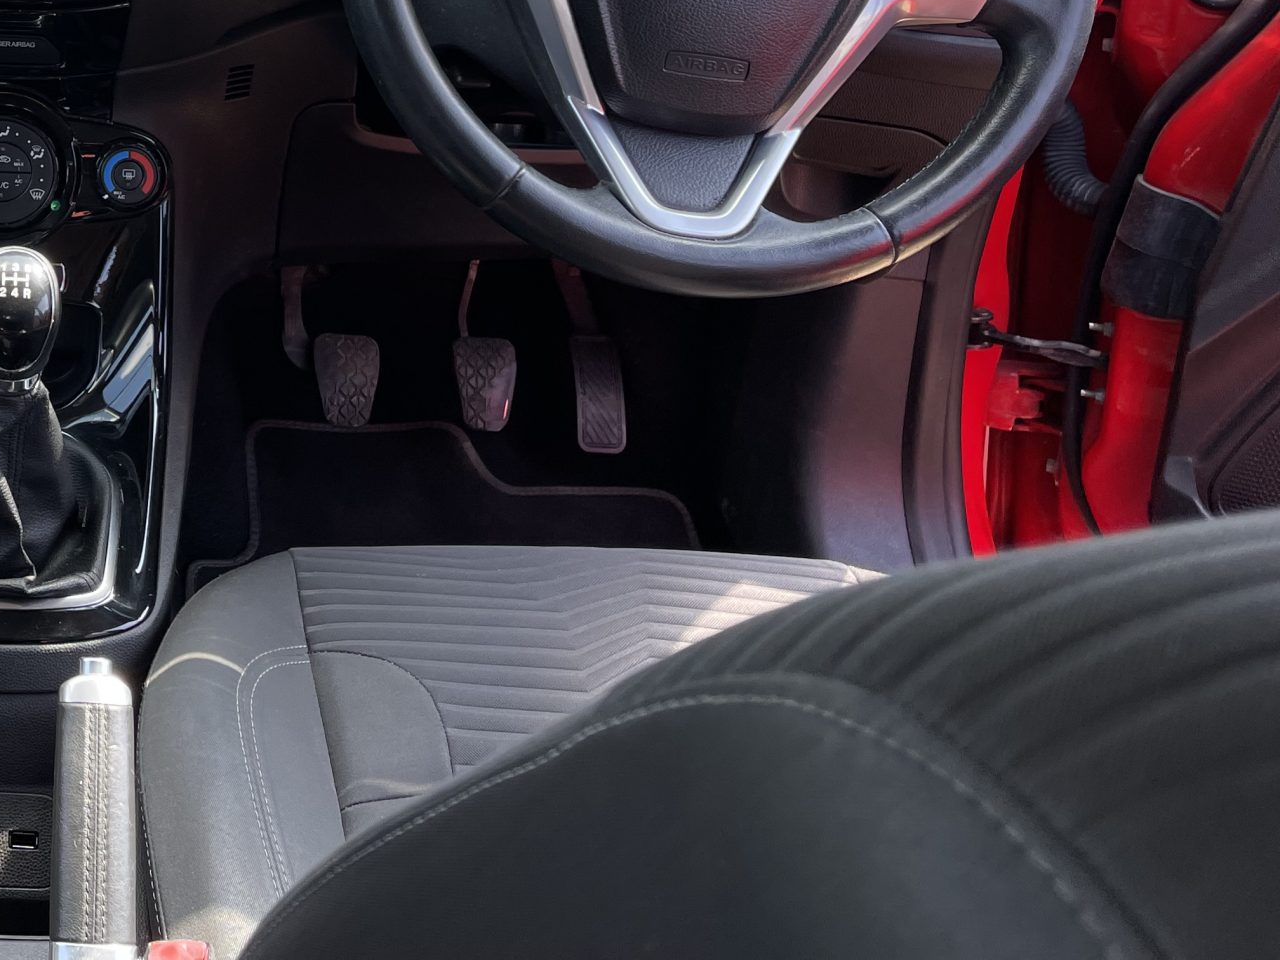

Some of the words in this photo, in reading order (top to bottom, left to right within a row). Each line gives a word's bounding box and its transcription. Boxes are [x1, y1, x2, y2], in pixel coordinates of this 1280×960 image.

[674, 55, 745, 75] AIRBAG
[12, 262, 20, 271] 3
[0, 286, 7, 298] 2
[10, 287, 19, 298] 4
[23, 287, 32, 300] R
